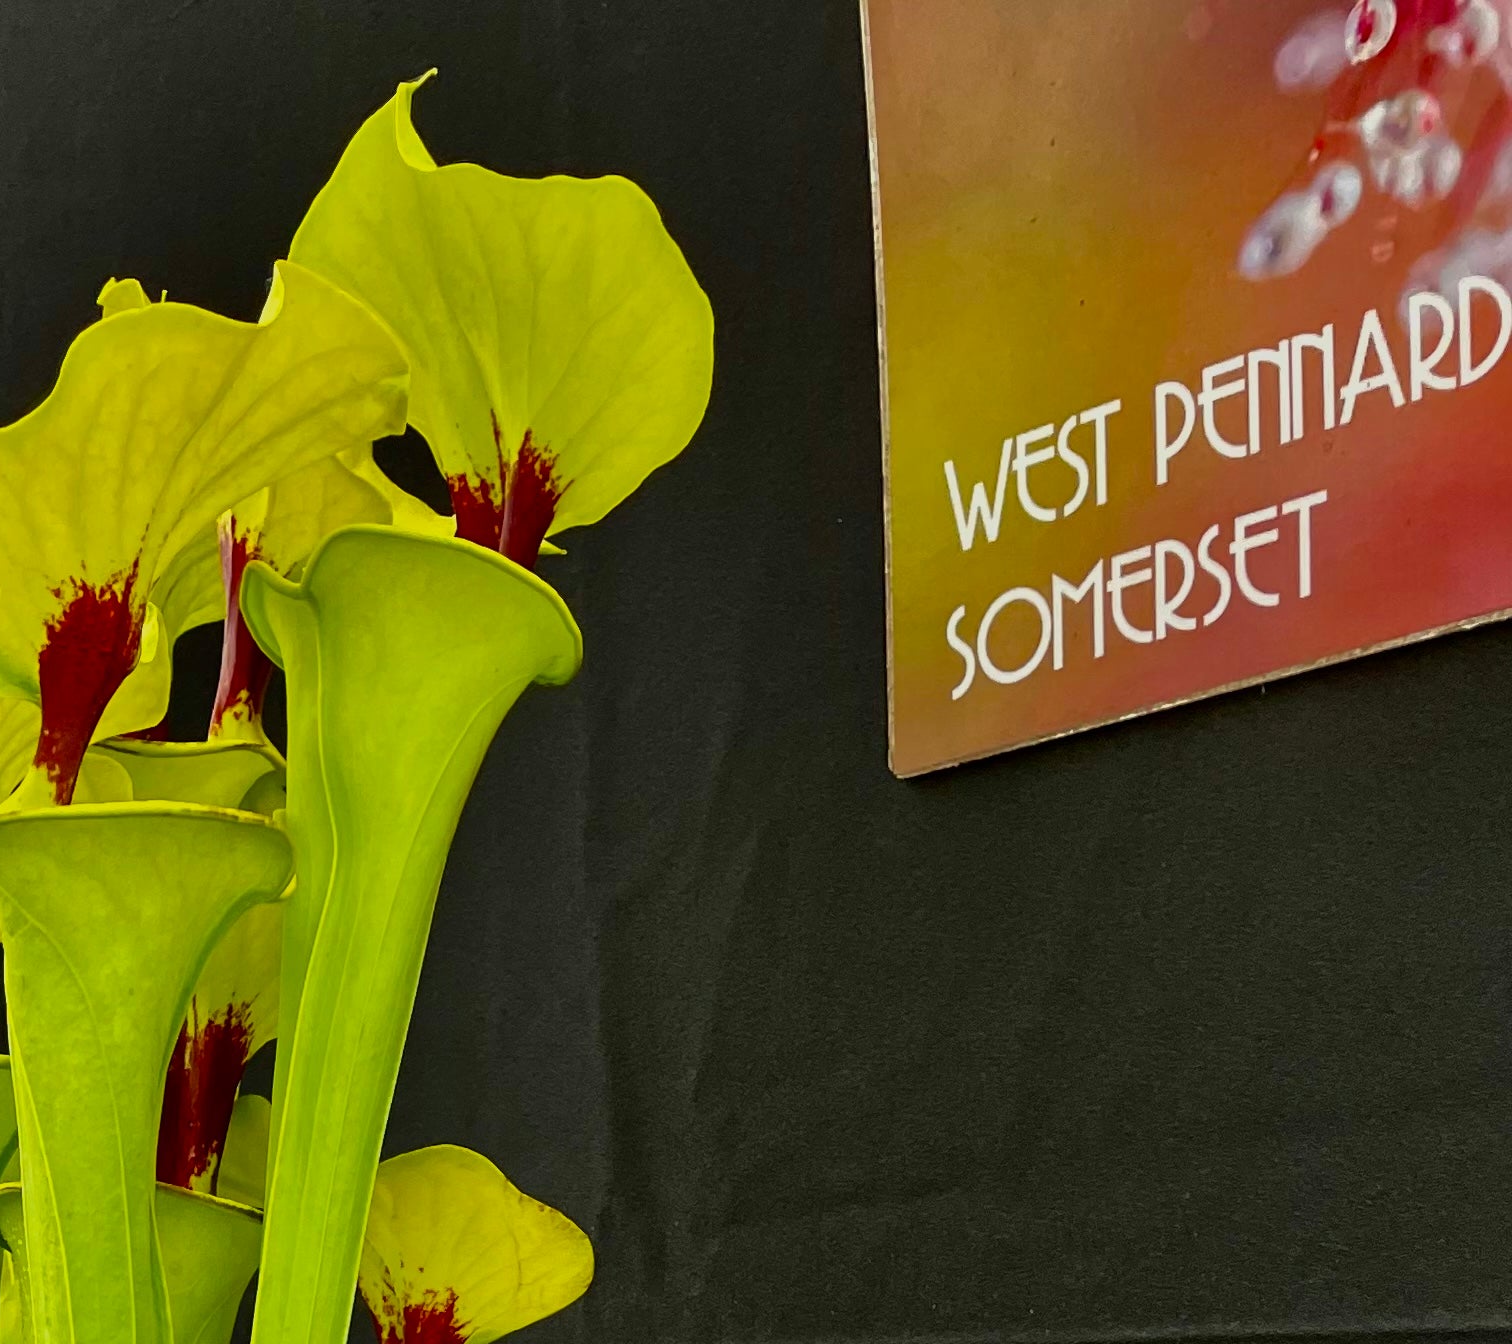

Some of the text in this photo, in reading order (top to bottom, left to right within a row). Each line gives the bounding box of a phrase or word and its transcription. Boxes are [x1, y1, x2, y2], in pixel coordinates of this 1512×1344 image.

[944, 275, 1512, 552] WEST PENNARD
[945, 490, 1328, 700] SOMERSET
